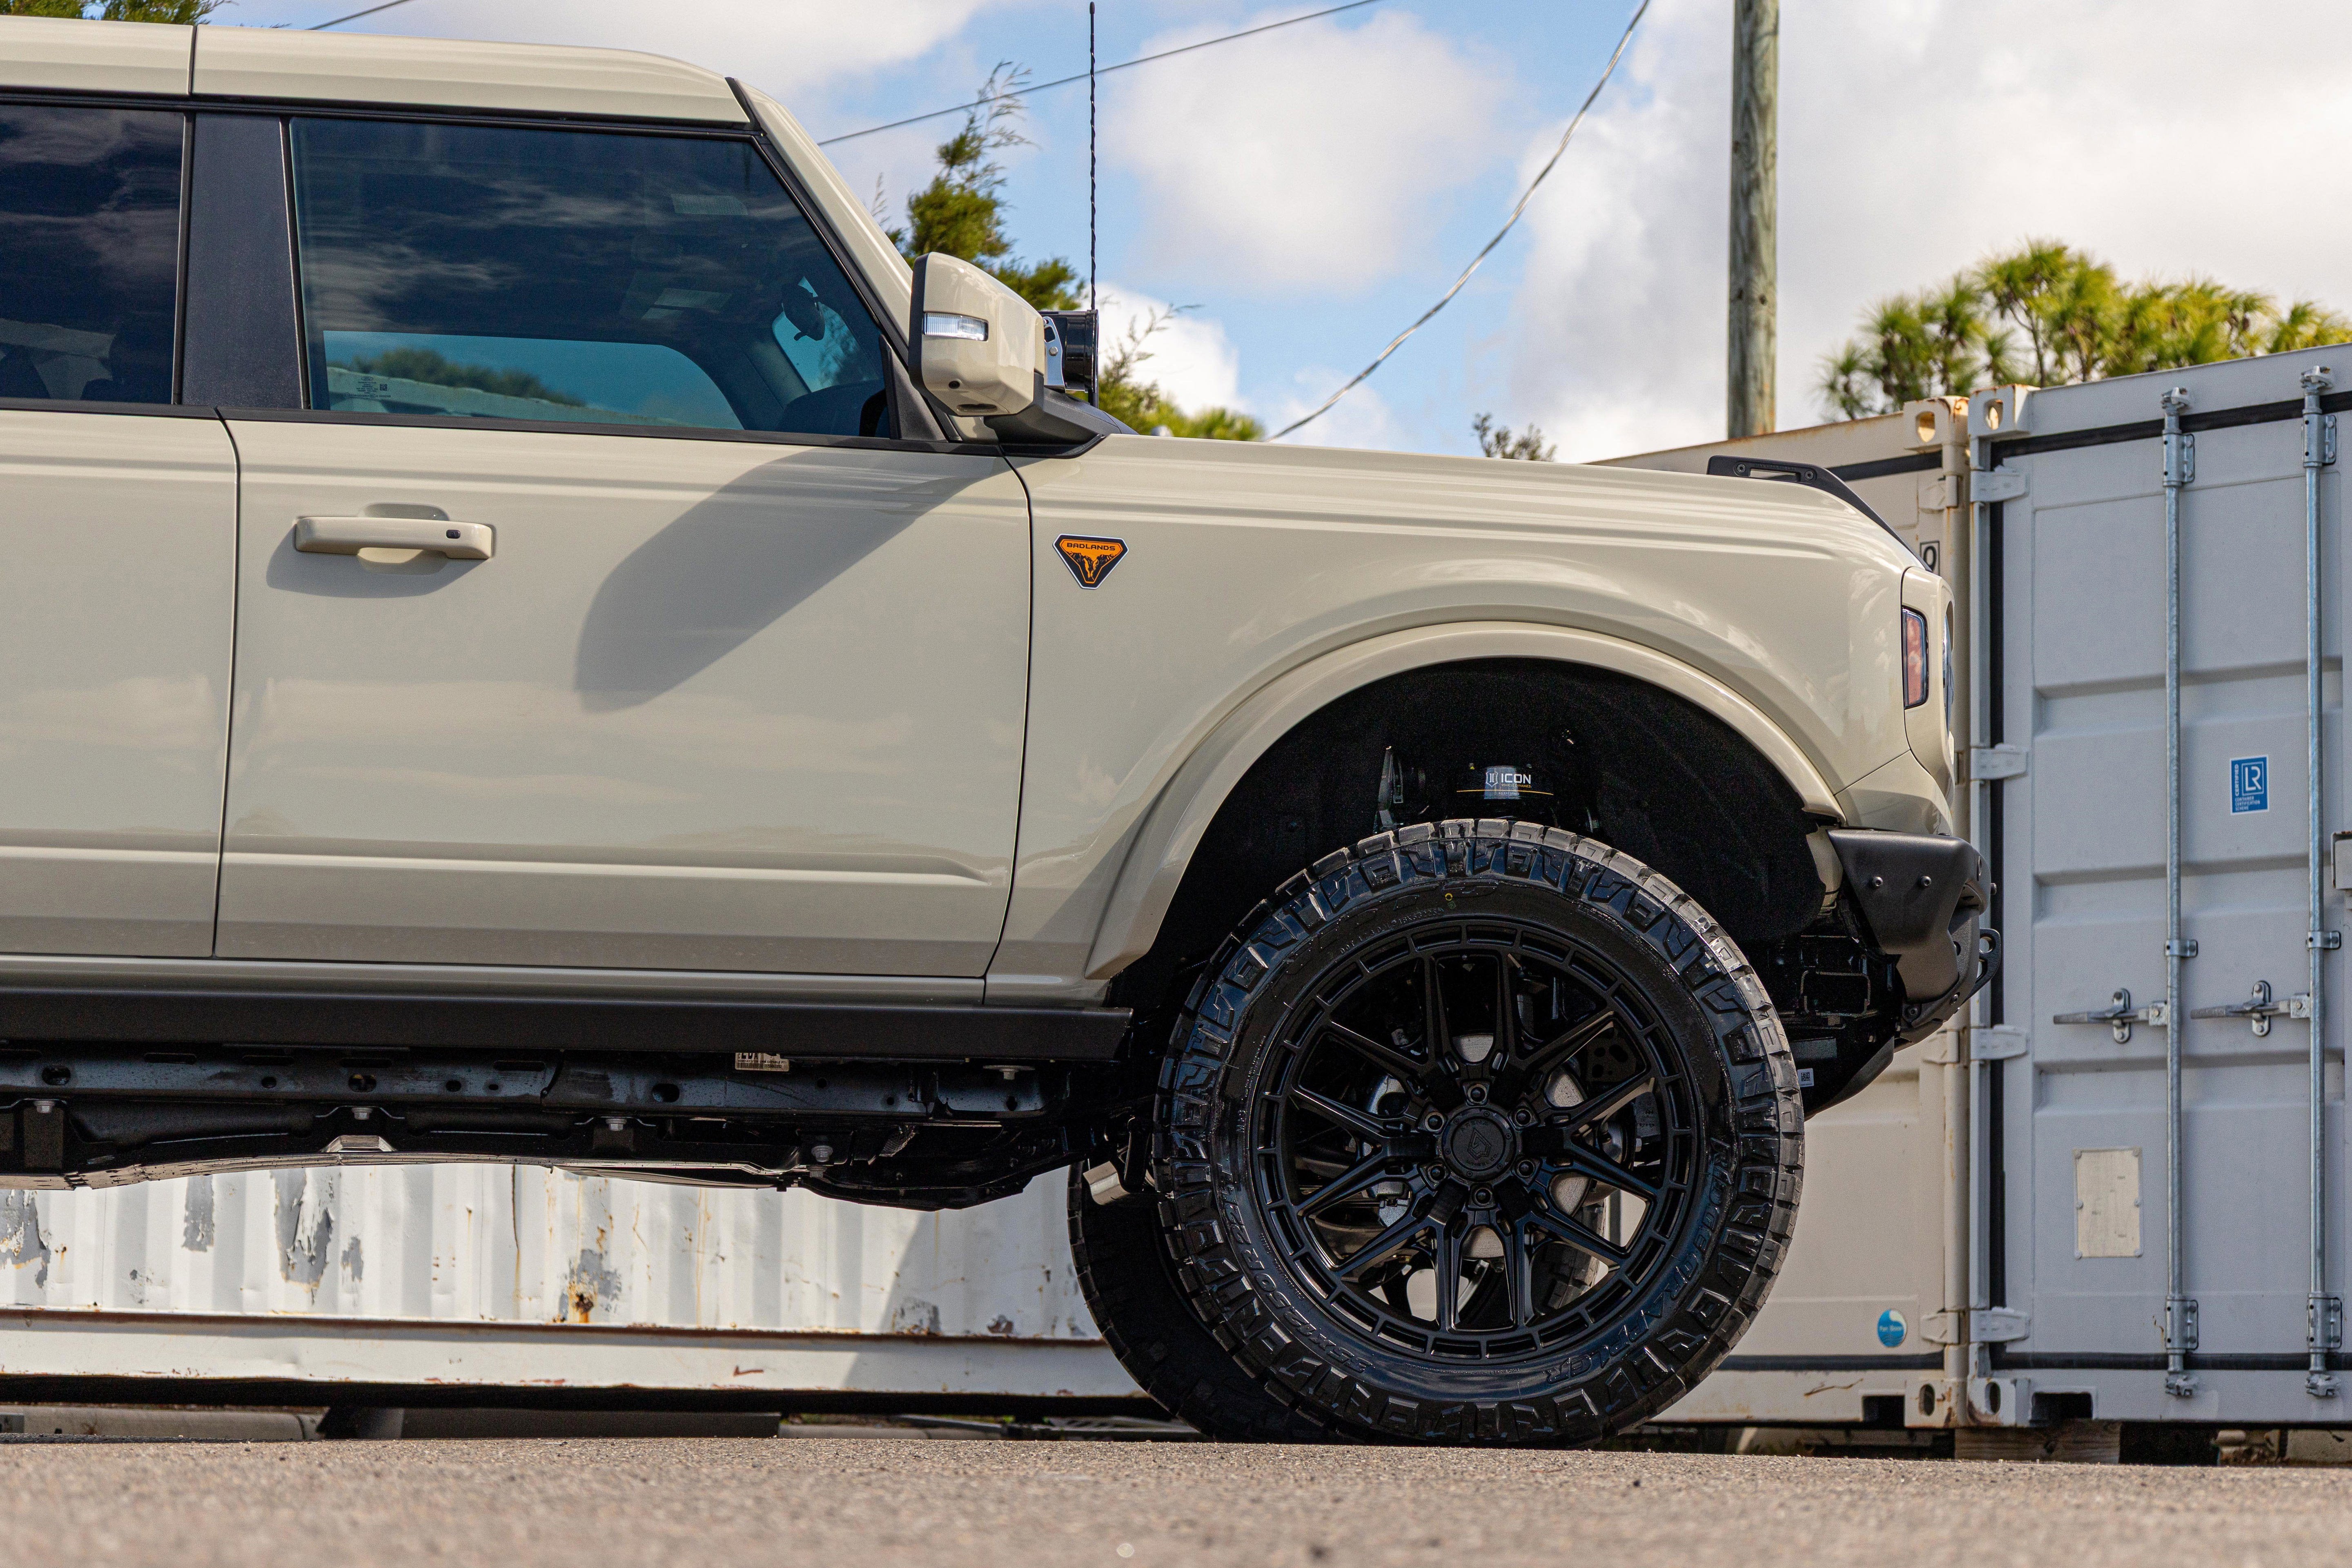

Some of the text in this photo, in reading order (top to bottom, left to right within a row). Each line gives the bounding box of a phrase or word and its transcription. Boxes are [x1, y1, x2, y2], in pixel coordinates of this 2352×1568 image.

[1067, 542, 1116, 551] BADLANDS
[1501, 773, 1531, 784] ICON
[2245, 766, 2262, 791] LR
[1545, 1137, 1734, 1385] RIDGE GRAPPLER
